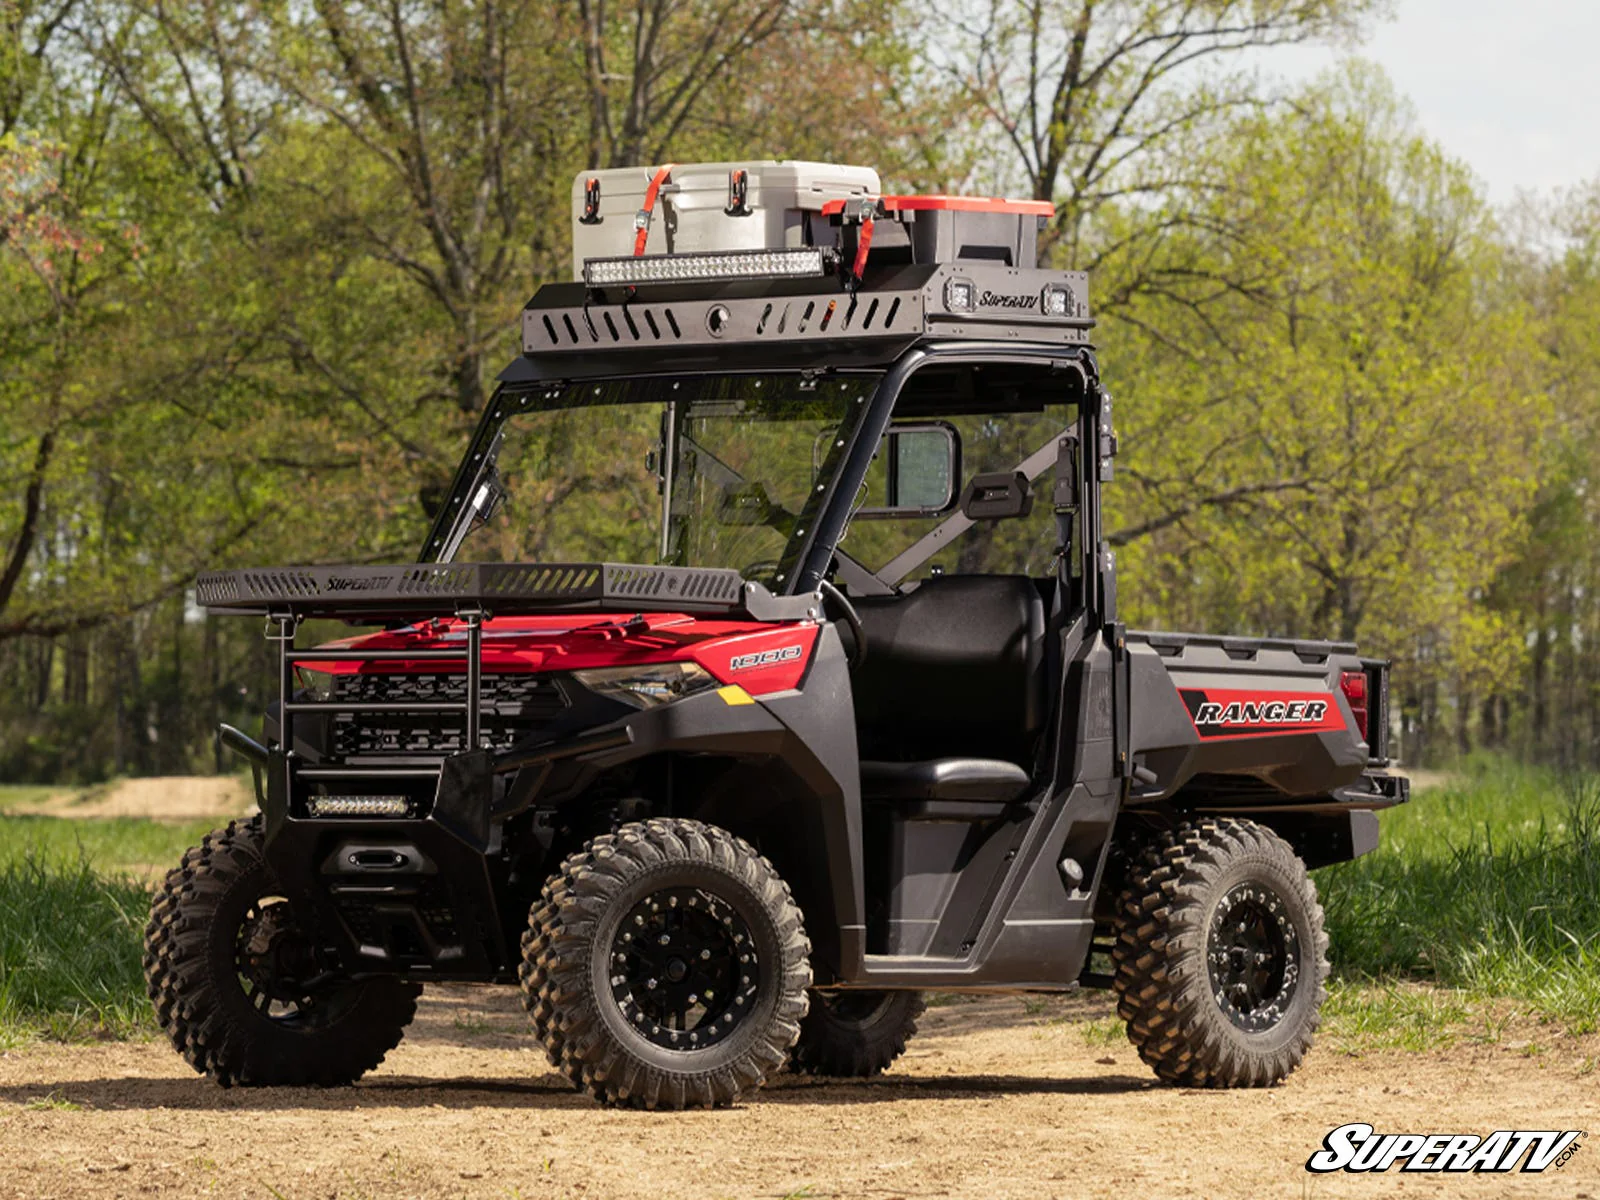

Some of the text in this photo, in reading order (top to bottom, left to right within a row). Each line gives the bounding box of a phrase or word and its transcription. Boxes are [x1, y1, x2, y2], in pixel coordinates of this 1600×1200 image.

[980, 291, 1038, 309] SUPERATV
[327, 575, 394, 591] SUPERATV
[730, 645, 802, 670] 1000
[1195, 700, 1327, 724] RANGER
